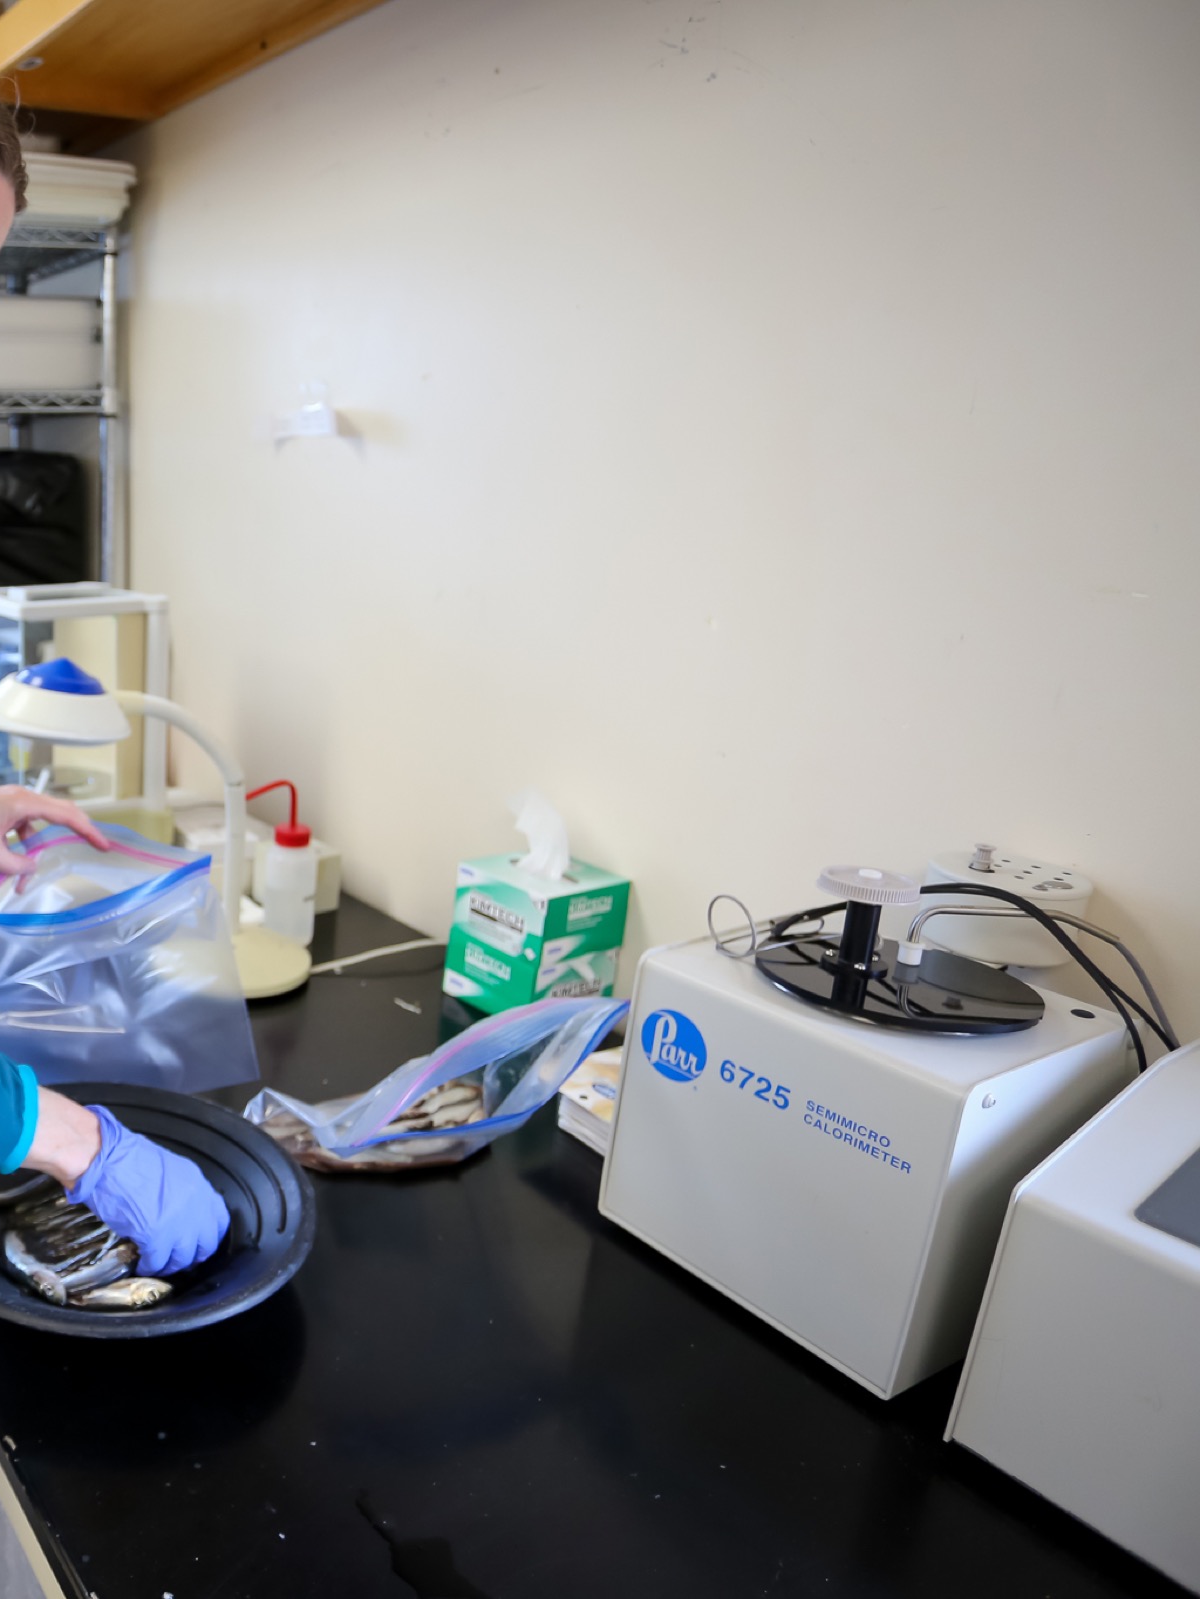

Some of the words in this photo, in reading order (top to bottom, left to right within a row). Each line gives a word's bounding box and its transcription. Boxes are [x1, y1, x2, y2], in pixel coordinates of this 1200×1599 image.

[650, 1012, 701, 1076] Parr
[719, 1058, 792, 1111] 6725
[803, 1113, 912, 1174] CALORIMETER
[805, 1099, 891, 1149] SEMIMICRO
